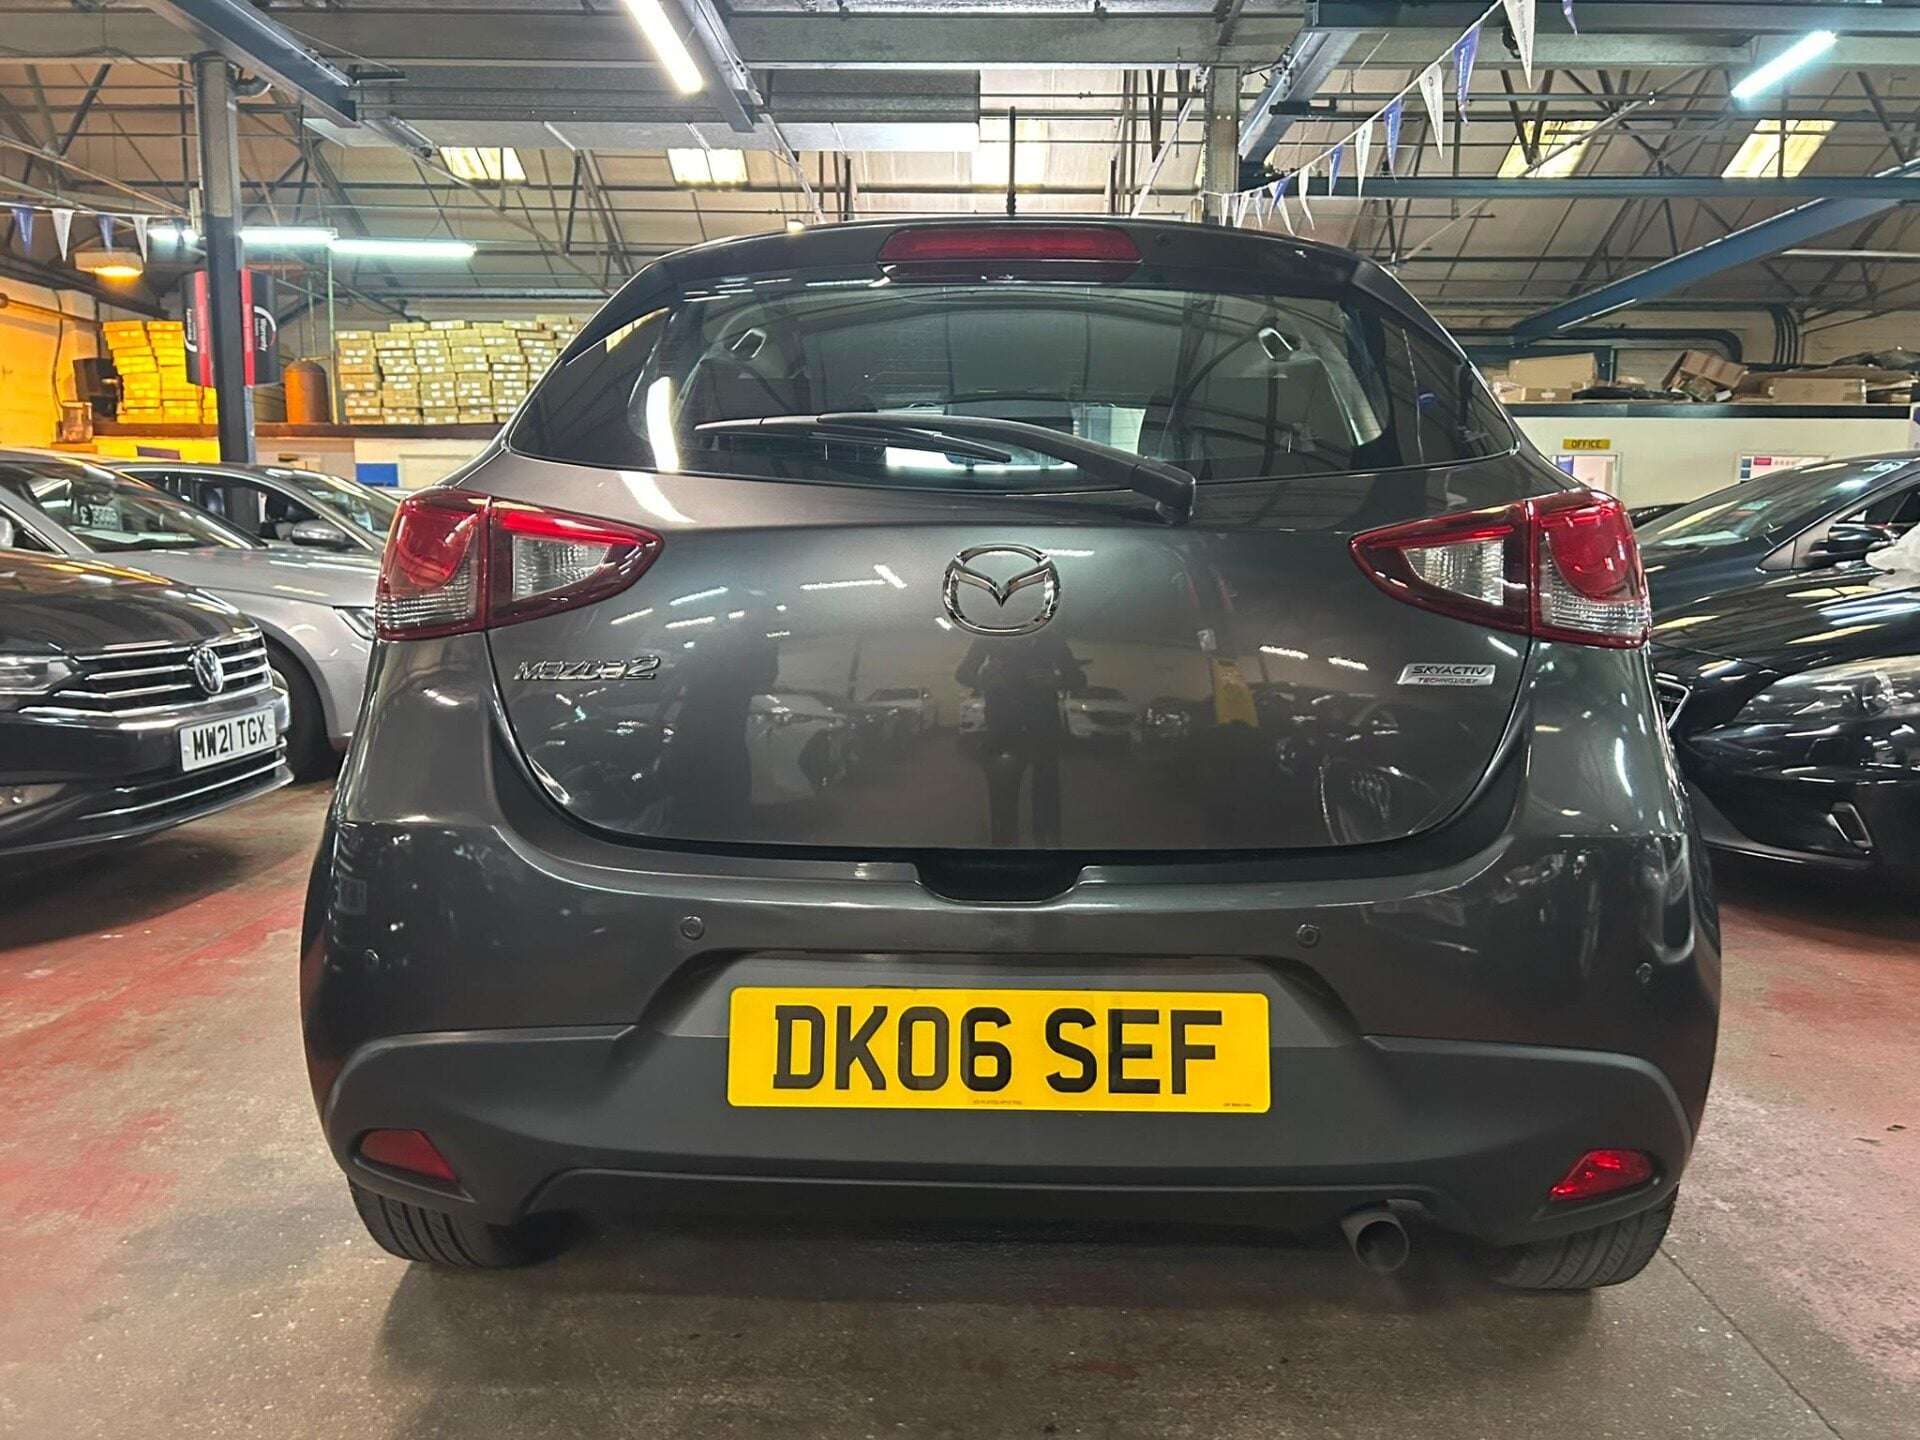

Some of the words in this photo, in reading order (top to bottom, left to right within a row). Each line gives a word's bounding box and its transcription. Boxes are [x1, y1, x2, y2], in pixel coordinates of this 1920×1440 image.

[1571, 440, 1601, 449] OFFICE
[1412, 665, 1487, 675] SKYACTIV
[192, 722, 233, 760] MW21
[237, 714, 267, 748] TGX
[773, 1005, 1012, 1092] DK06
[1045, 1007, 1222, 1095] SEF
